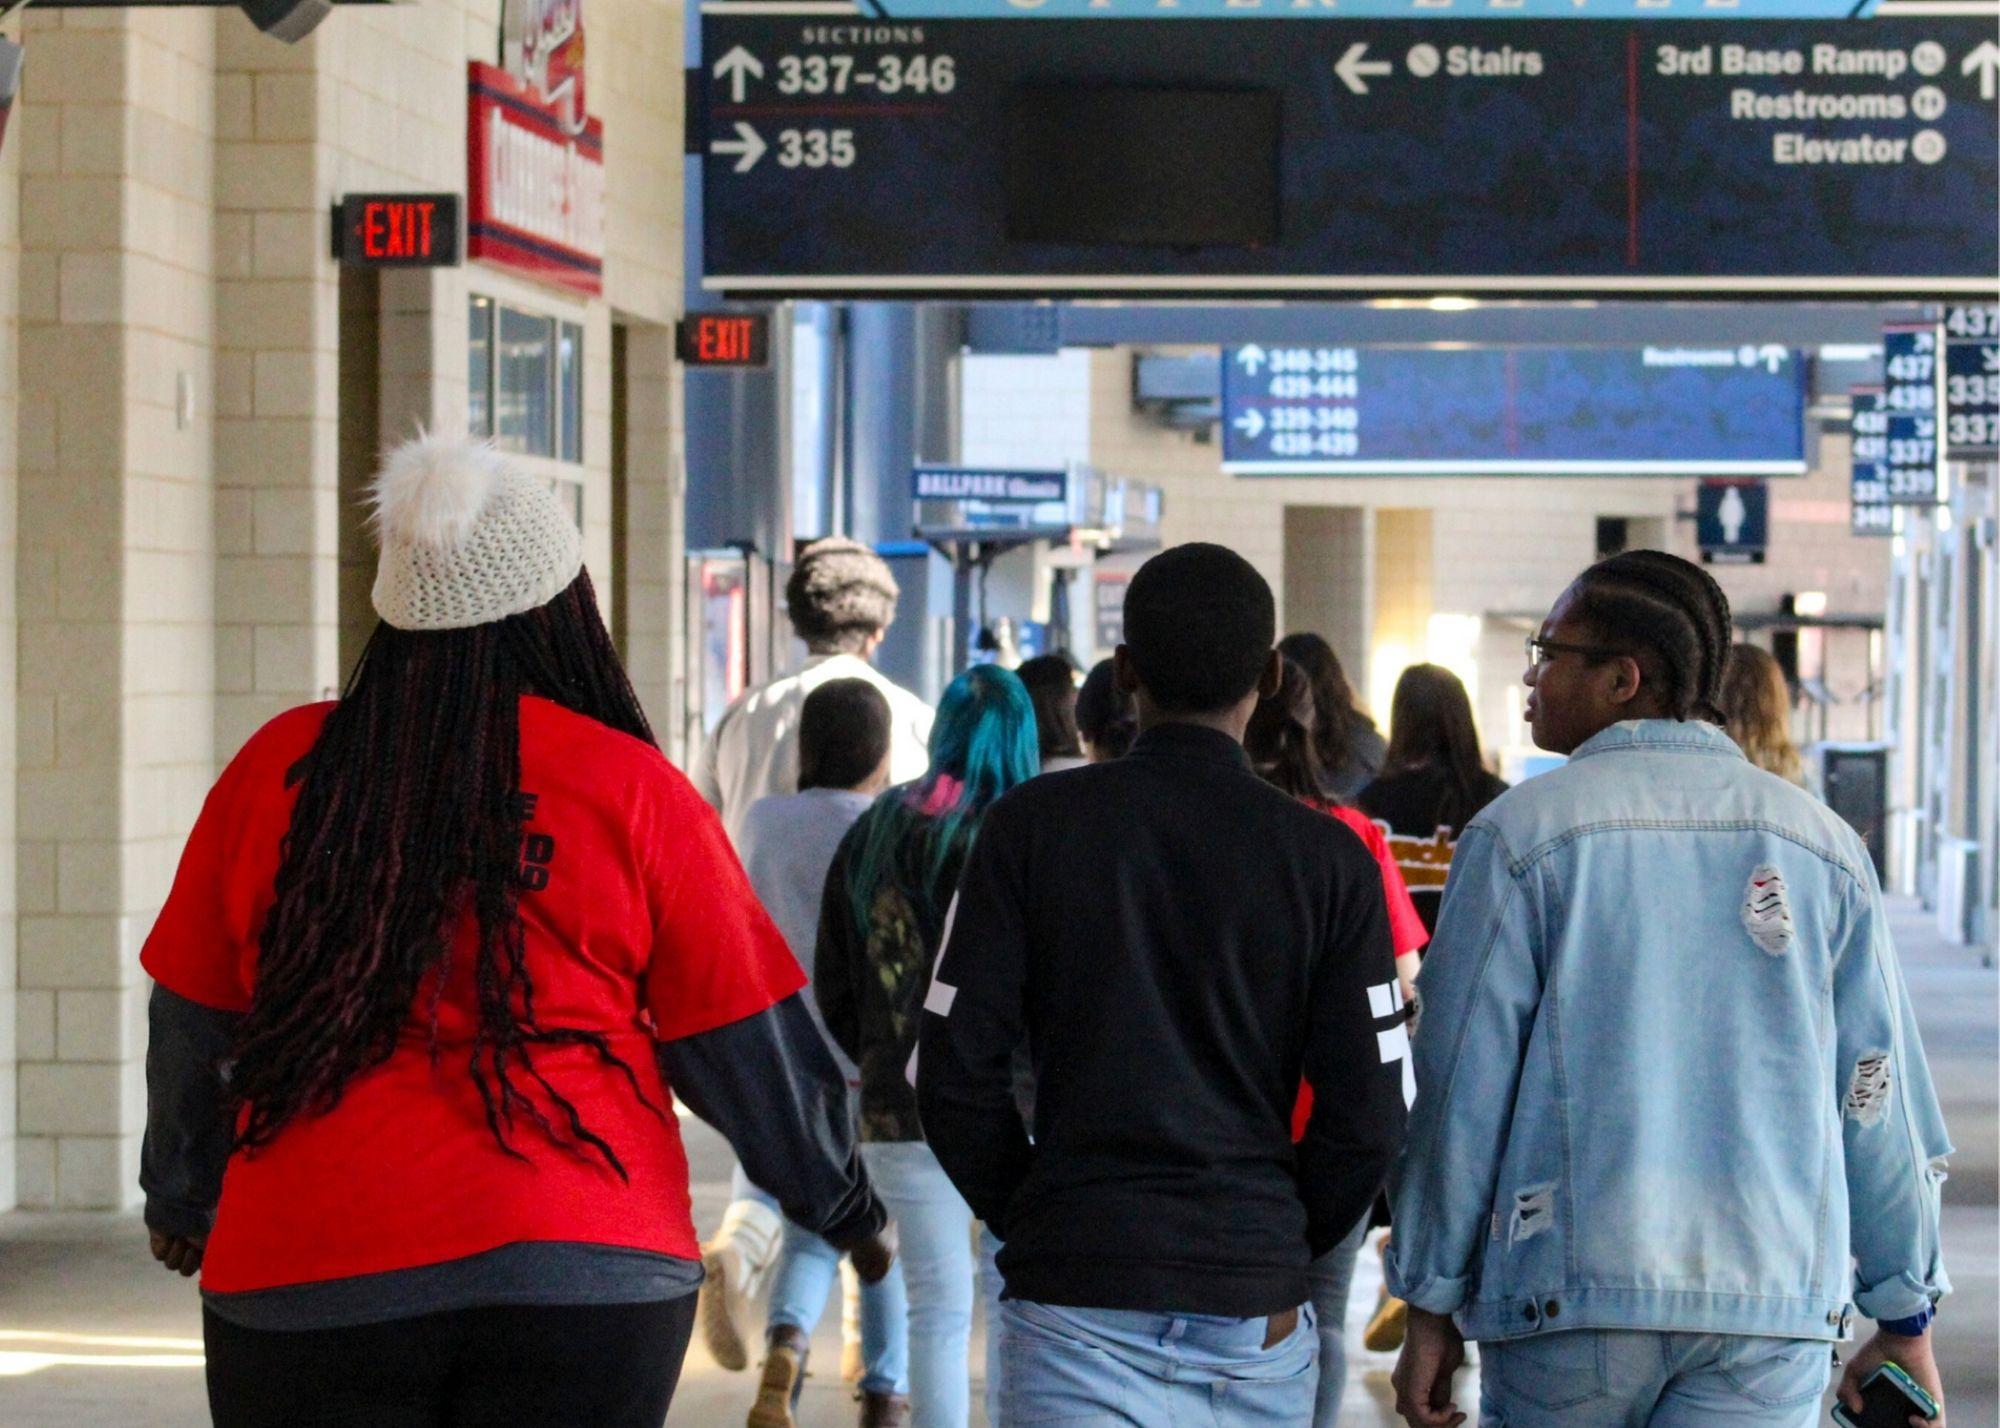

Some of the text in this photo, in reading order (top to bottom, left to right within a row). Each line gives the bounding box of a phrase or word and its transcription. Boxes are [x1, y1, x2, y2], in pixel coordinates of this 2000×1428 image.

[802, 26, 925, 45] SECTIONS
[777, 54, 956, 95] 337-346
[1446, 45, 1544, 76] Stairs
[1656, 44, 1908, 80] 3rd Base Ramp
[1731, 88, 1907, 120] Restrooms
[777, 129, 856, 168] 335
[1773, 132, 1908, 164] Elevator
[364, 202, 434, 258] EXIT
[699, 319, 752, 361] EXIT
[1888, 355, 1934, 381] 437
[1889, 439, 1934, 466] 337
